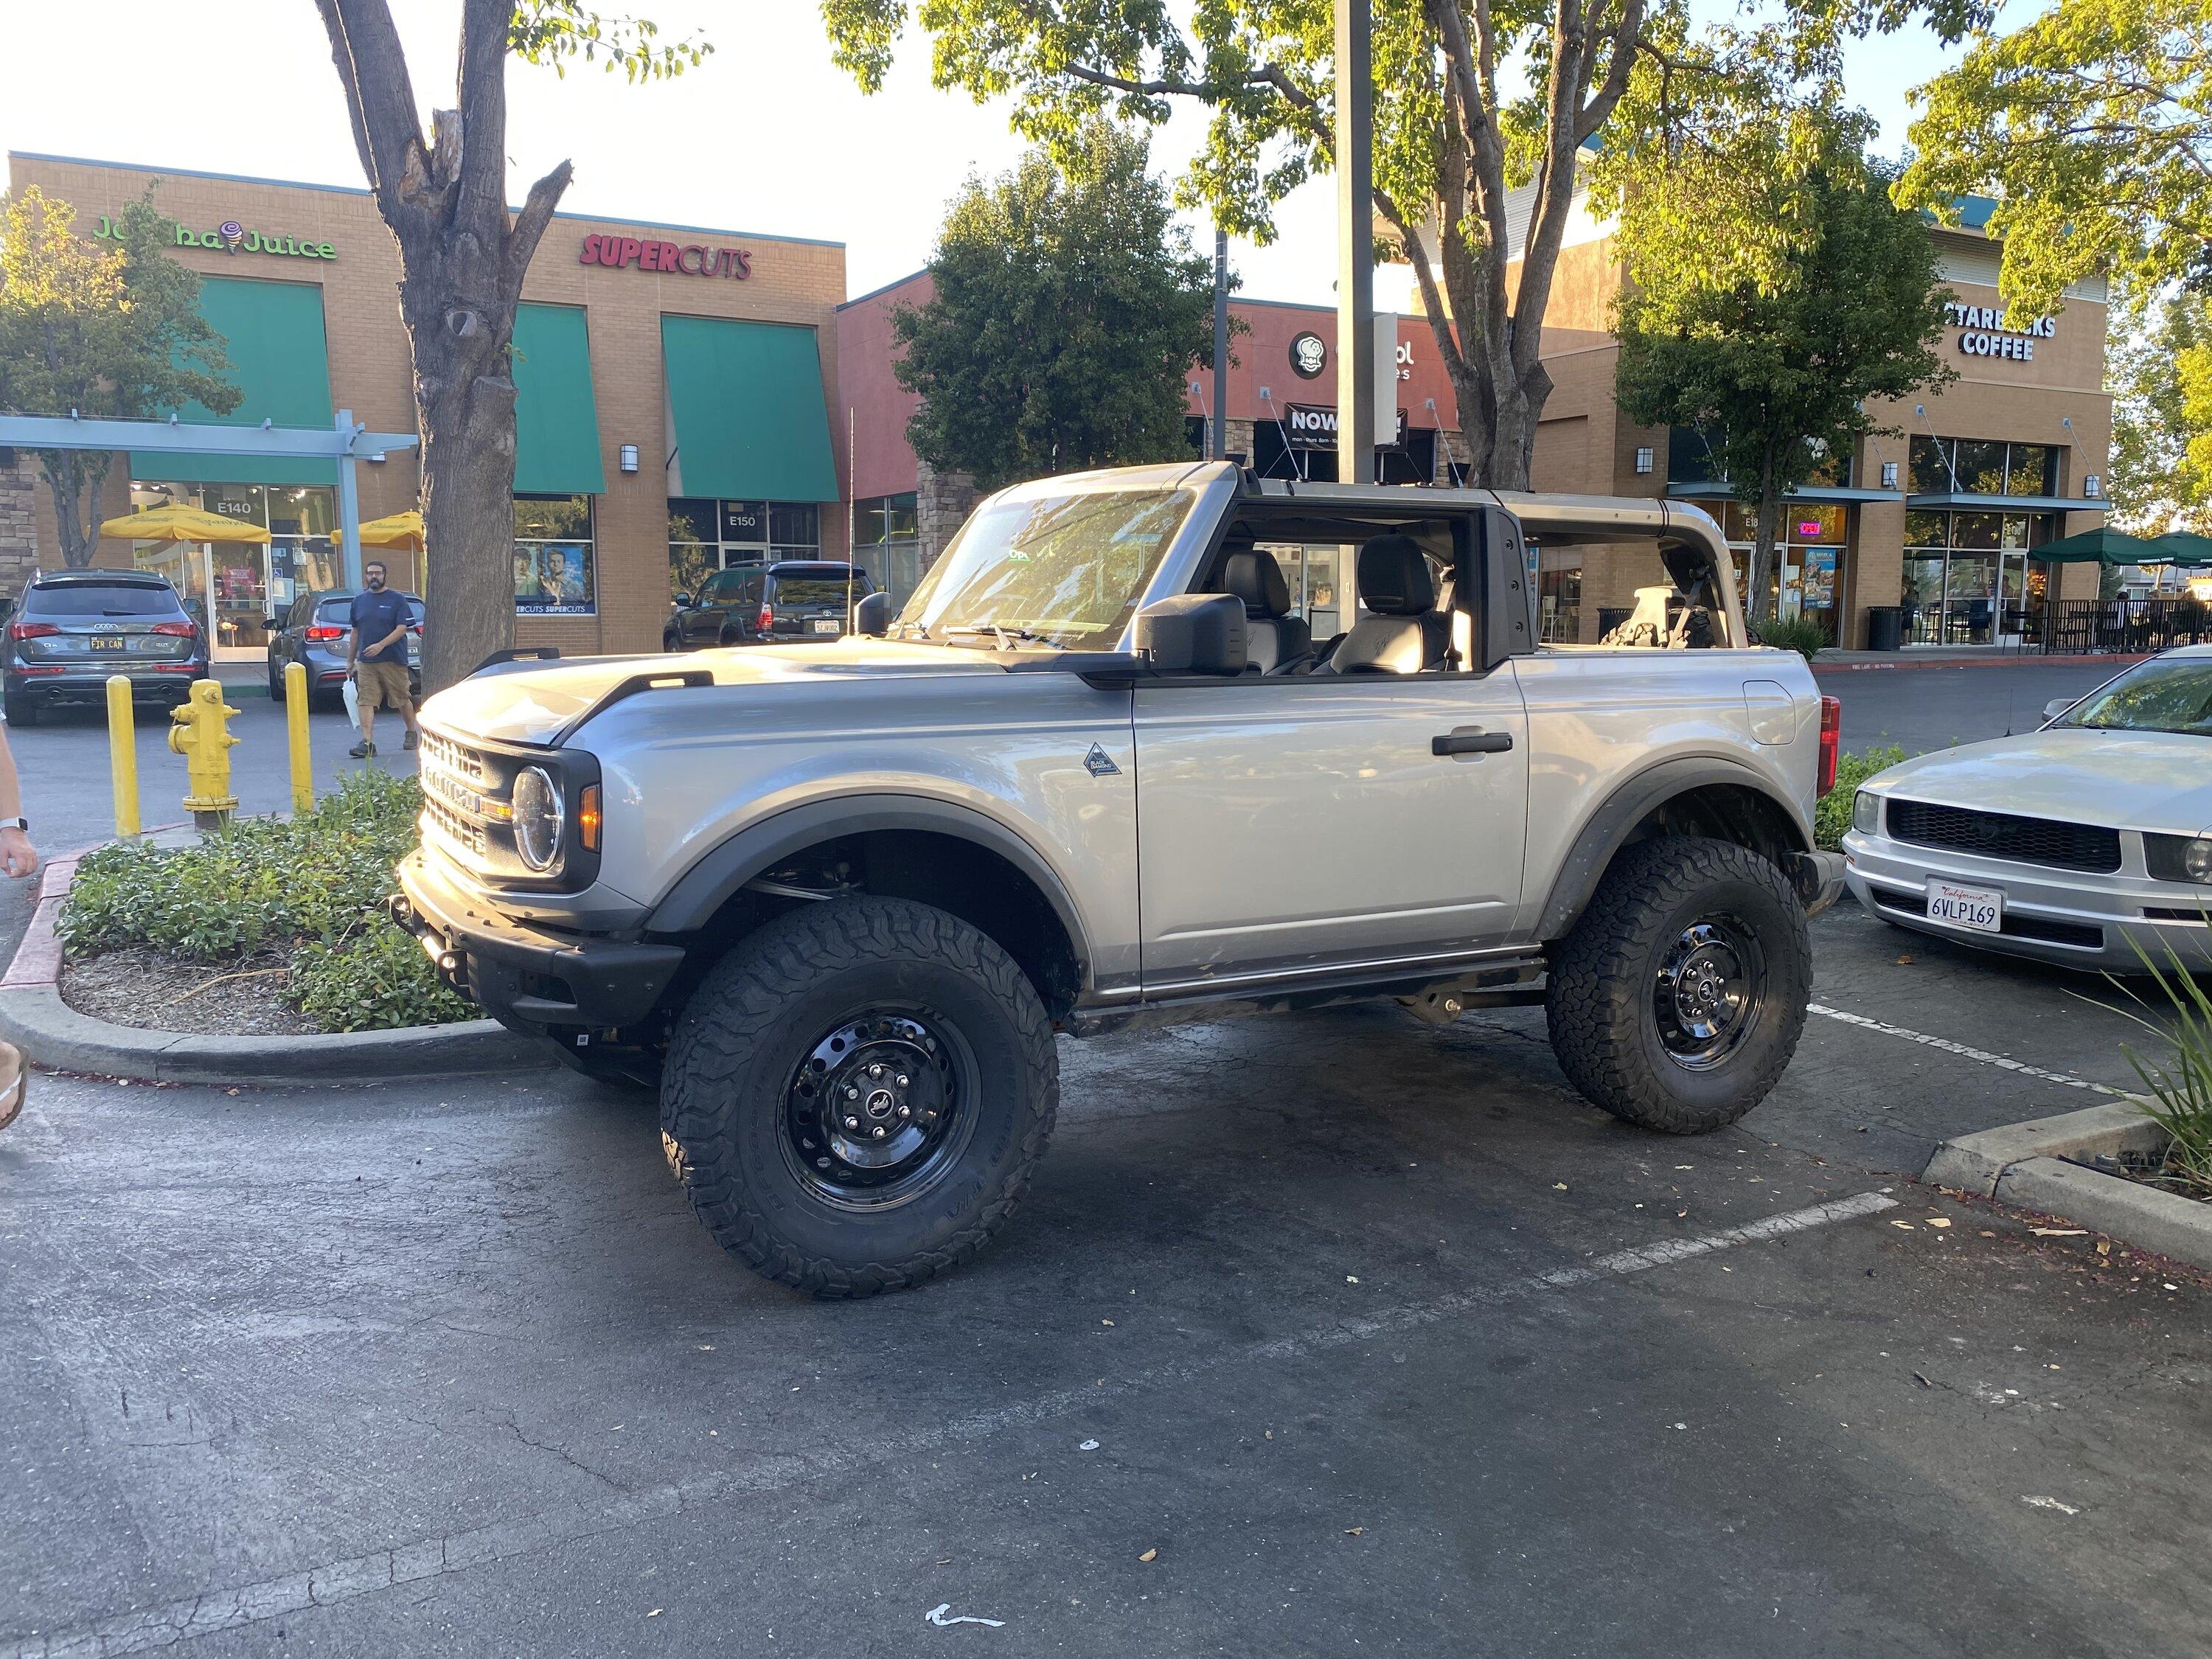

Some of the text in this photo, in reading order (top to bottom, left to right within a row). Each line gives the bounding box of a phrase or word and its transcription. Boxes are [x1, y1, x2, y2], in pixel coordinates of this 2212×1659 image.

[92, 215, 337, 260] Jaba Juice
[580, 234, 752, 280] SUPERCUTS
[1944, 302, 2056, 338] STARBKS
[1962, 332, 2034, 361] COFFEE
[1292, 411, 1338, 431] NOW
[218, 502, 251, 514] E140
[729, 516, 756, 526] E150
[1745, 518, 1759, 527] E18
[1801, 524, 1818, 532] OPEN
[91, 640, 122, 648] FIR CAN
[1943, 886, 1986, 902] California
[1932, 898, 1995, 925] 6VLP169
